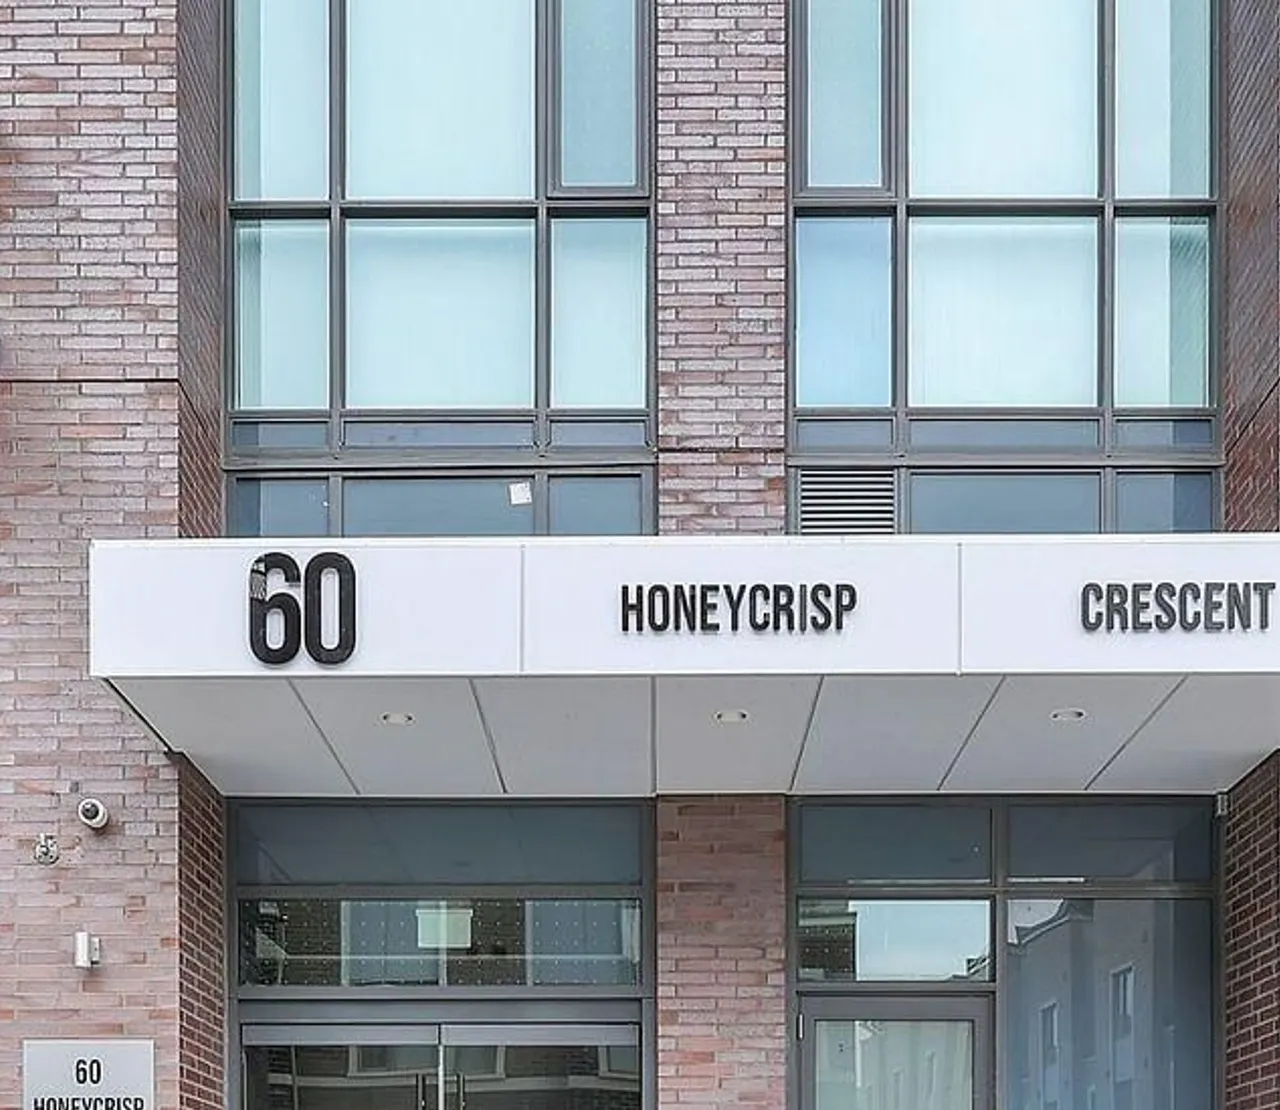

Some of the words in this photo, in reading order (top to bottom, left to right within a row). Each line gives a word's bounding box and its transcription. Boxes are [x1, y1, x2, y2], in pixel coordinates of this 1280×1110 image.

[248, 552, 357, 666] 60
[621, 583, 857, 635] HONEYCRISP
[1081, 582, 1276, 634] CRESCENT
[75, 1059, 102, 1084] 60
